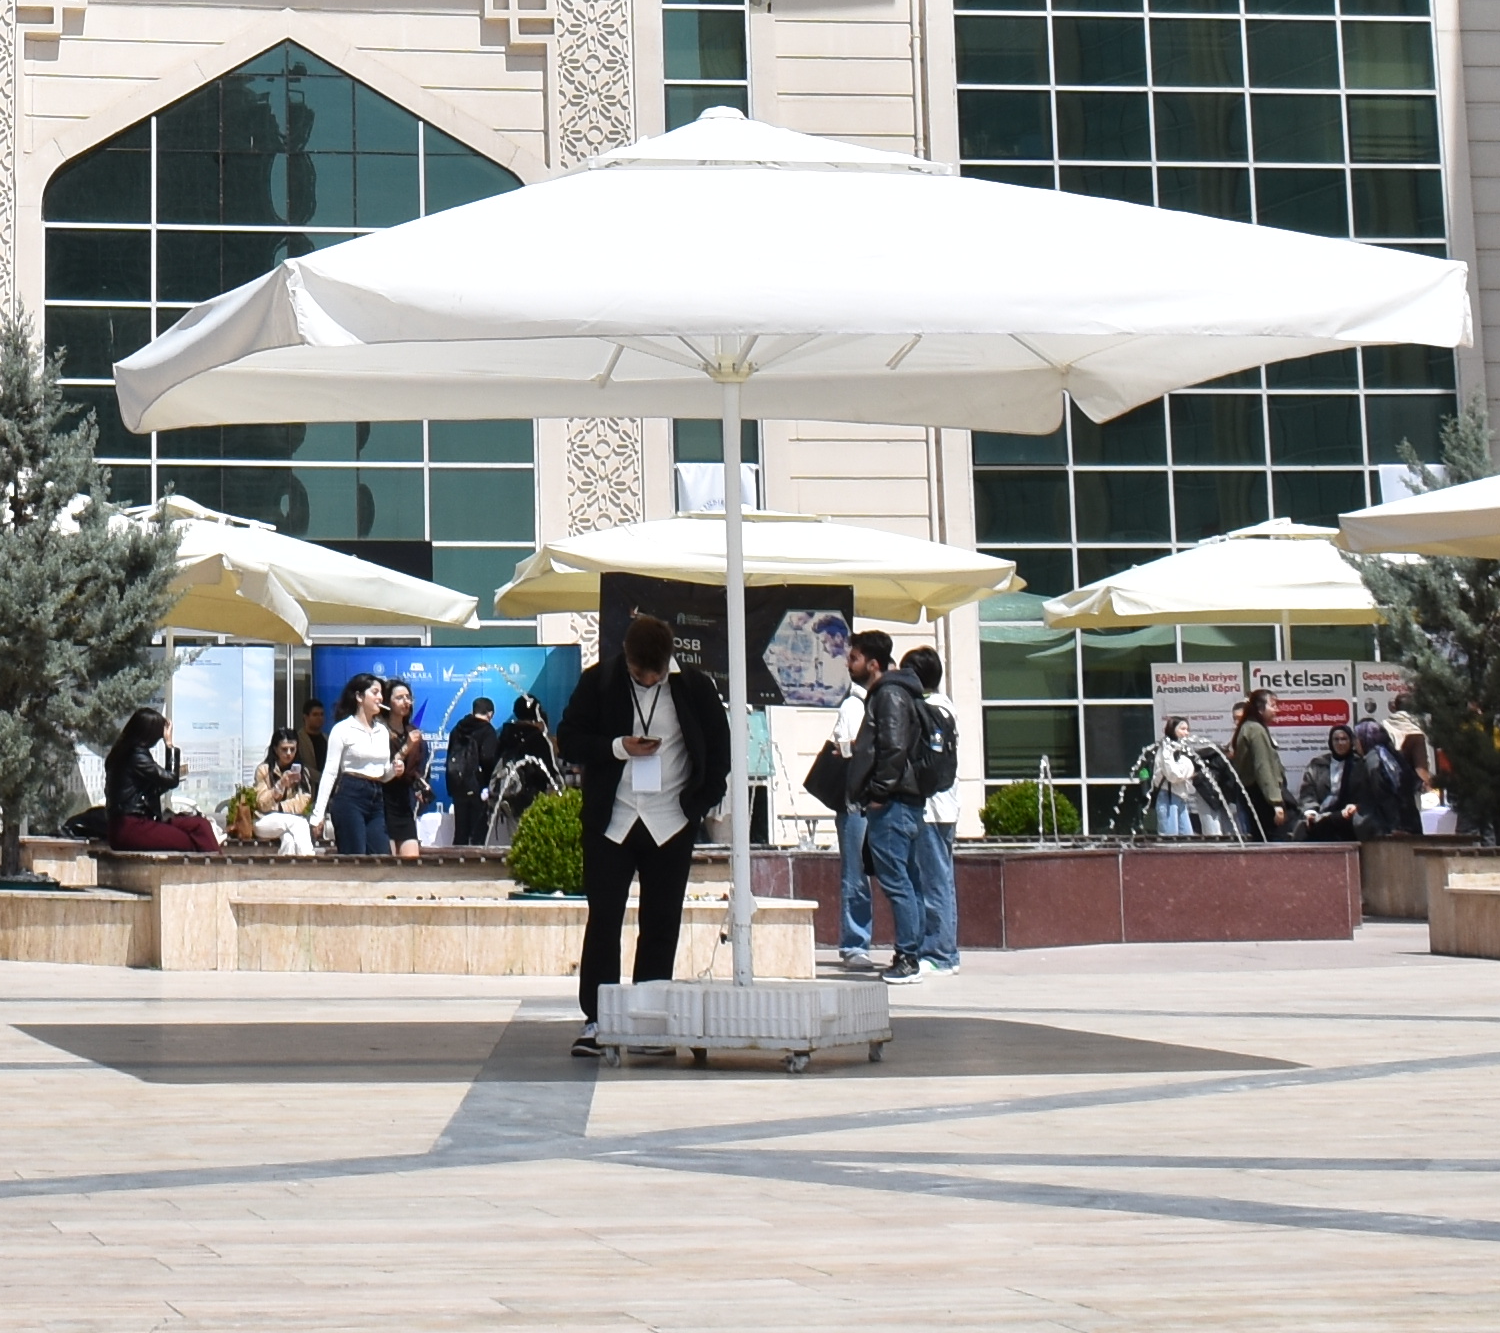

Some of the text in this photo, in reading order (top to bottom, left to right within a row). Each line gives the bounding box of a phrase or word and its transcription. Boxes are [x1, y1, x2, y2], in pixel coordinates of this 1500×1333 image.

[673, 637, 701, 651] OSB
[1155, 673, 1238, 685] Eğitim ile Kariyer
[1260, 669, 1345, 687] netelsan
[1156, 683, 1241, 694] Arasındaki Köprü
[1363, 682, 1384, 692] Daha
